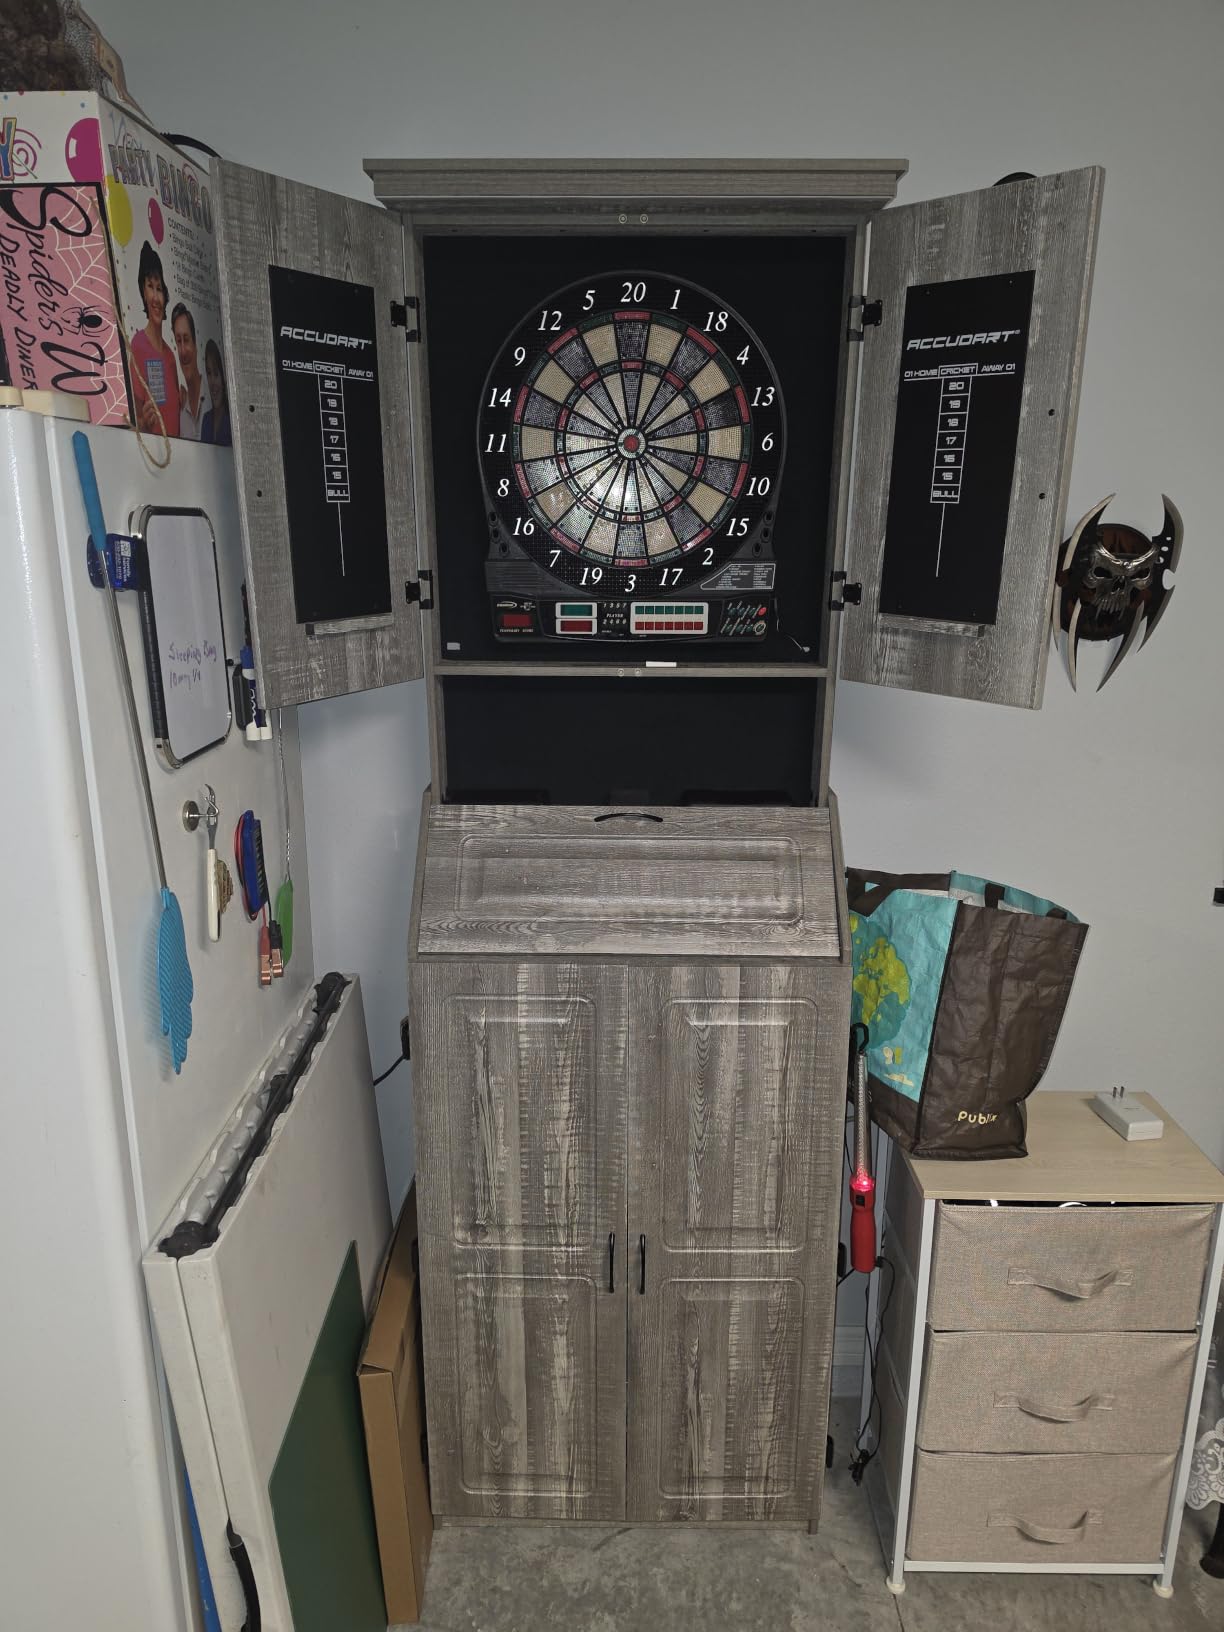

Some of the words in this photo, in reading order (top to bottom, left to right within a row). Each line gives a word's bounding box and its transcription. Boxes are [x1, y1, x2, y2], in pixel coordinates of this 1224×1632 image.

[108, 144, 156, 187] PARTY
[156, 153, 213, 233] BINGO
[582, 290, 595, 310] 5
[621, 282, 645, 302] 20
[671, 290, 680, 309] 1
[0, 232, 27, 321] DEADLY
[14, 326, 39, 391] DINER
[539, 311, 561, 330] 12
[704, 312, 728, 331] 18
[280, 326, 370, 350] ACCUDART
[906, 330, 1015, 351] ACCUDART
[514, 347, 525, 366] 9
[737, 346, 749, 364] 4
[292, 361, 313, 370] HOME
[314, 363, 344, 375] CRICKET
[348, 368, 365, 377] AWAY
[914, 368, 938, 377] HOME
[940, 366, 976, 375] CRICKET
[981, 363, 1004, 373] AWAY
[324, 379, 338, 390] 20
[948, 381, 964, 391] 20
[326, 398, 338, 408] 19
[489, 388, 511, 407] 14
[752, 387, 774, 406] 13
[949, 399, 961, 409] 19
[948, 418, 959, 427] 18
[330, 435, 339, 444] 17
[485, 434, 506, 452] 11
[762, 432, 773, 450] 6
[946, 436, 957, 445] 17
[330, 453, 341, 462] 16
[944, 454, 955, 463] 16
[332, 471, 342, 480] 15
[942, 472, 954, 481] 15
[327, 489, 349, 497] BULL
[497, 479, 509, 496] 8
[747, 478, 769, 495] 10
[932, 490, 958, 498] BULL
[513, 518, 535, 535] 16
[727, 518, 749, 536] 15
[550, 550, 560, 567] 7
[703, 548, 713, 565] 2
[580, 568, 602, 585] 19
[625, 575, 636, 592] 3
[660, 569, 683, 585] 17
[957, 1110, 998, 1125] Publix
